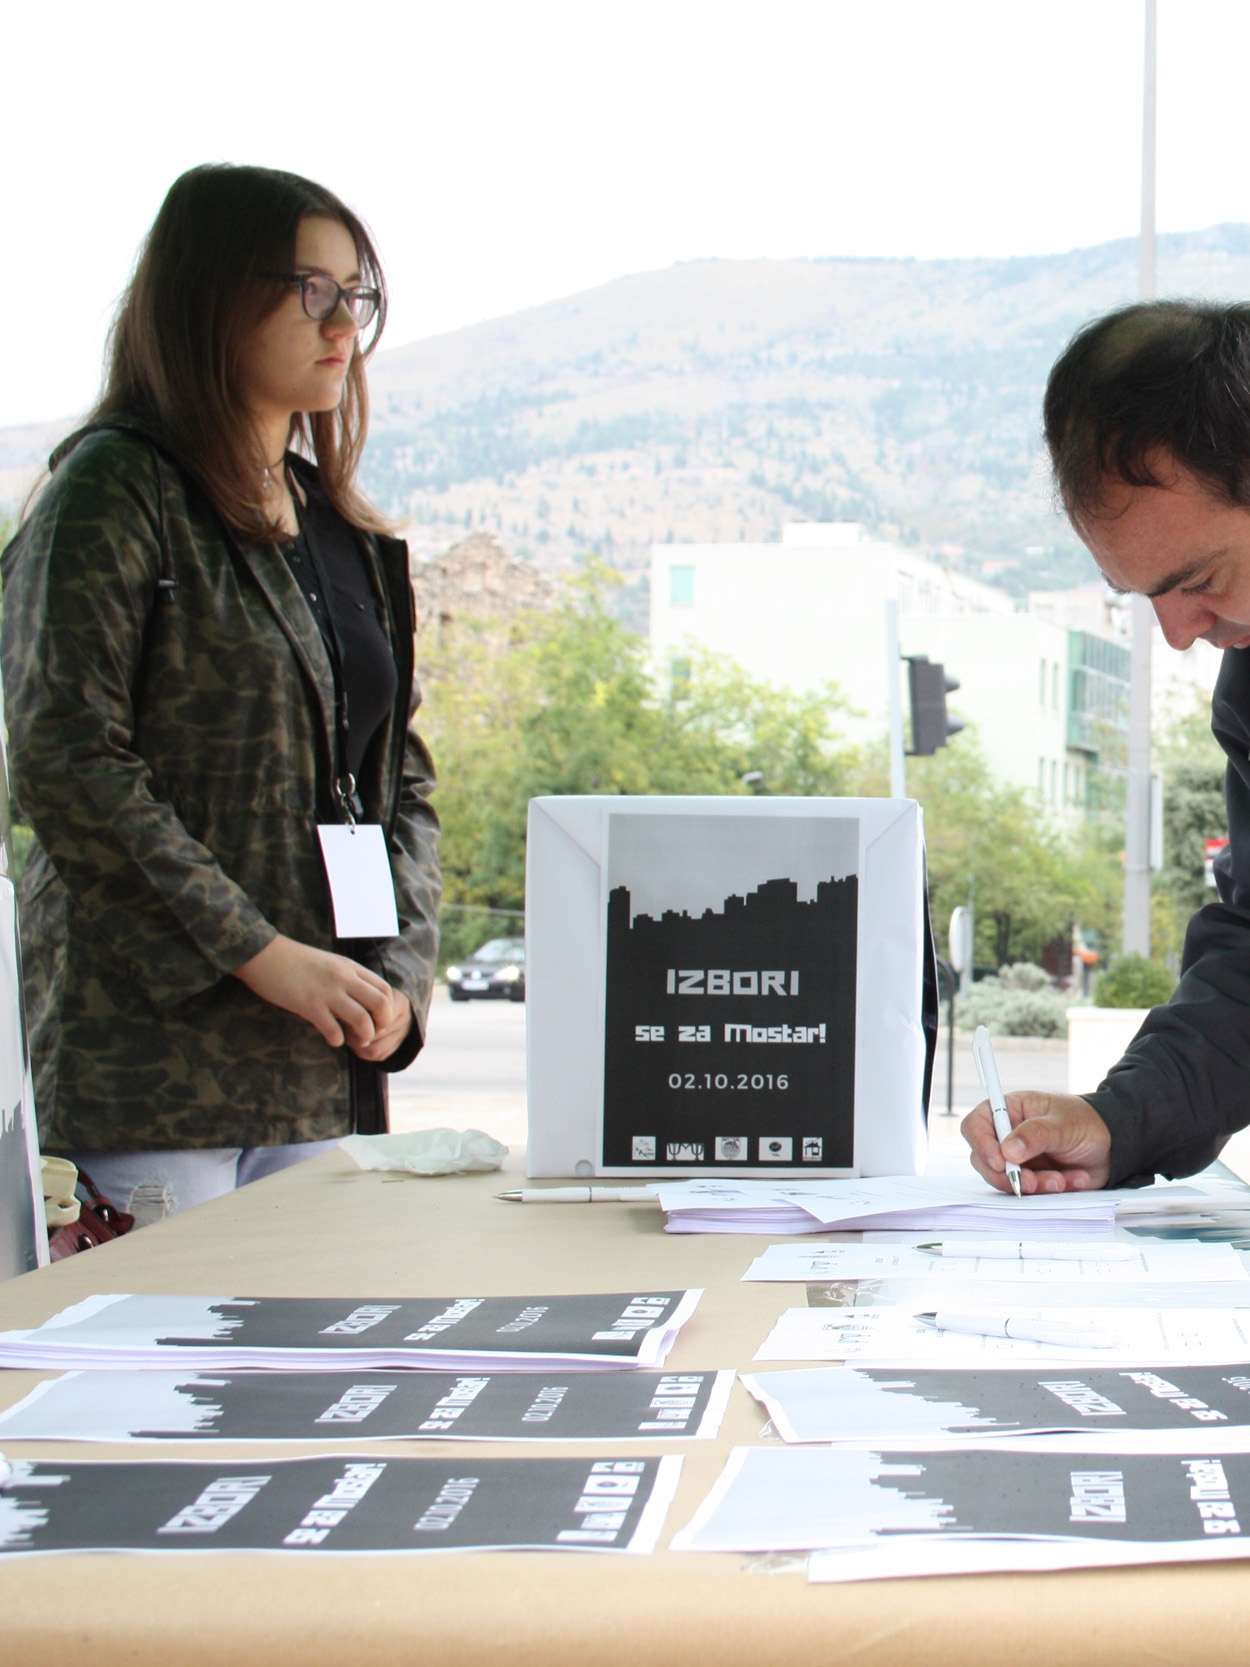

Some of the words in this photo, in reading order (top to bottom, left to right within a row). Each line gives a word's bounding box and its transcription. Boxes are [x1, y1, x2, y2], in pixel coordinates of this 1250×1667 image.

[666, 969, 799, 996] IZBORI
[635, 1025, 665, 1042] se
[678, 1025, 711, 1042] za
[724, 1023, 827, 1044] Mostar!
[668, 1073, 789, 1090] 02.10.2016
[1069, 1470, 1127, 1524] IZBORI
